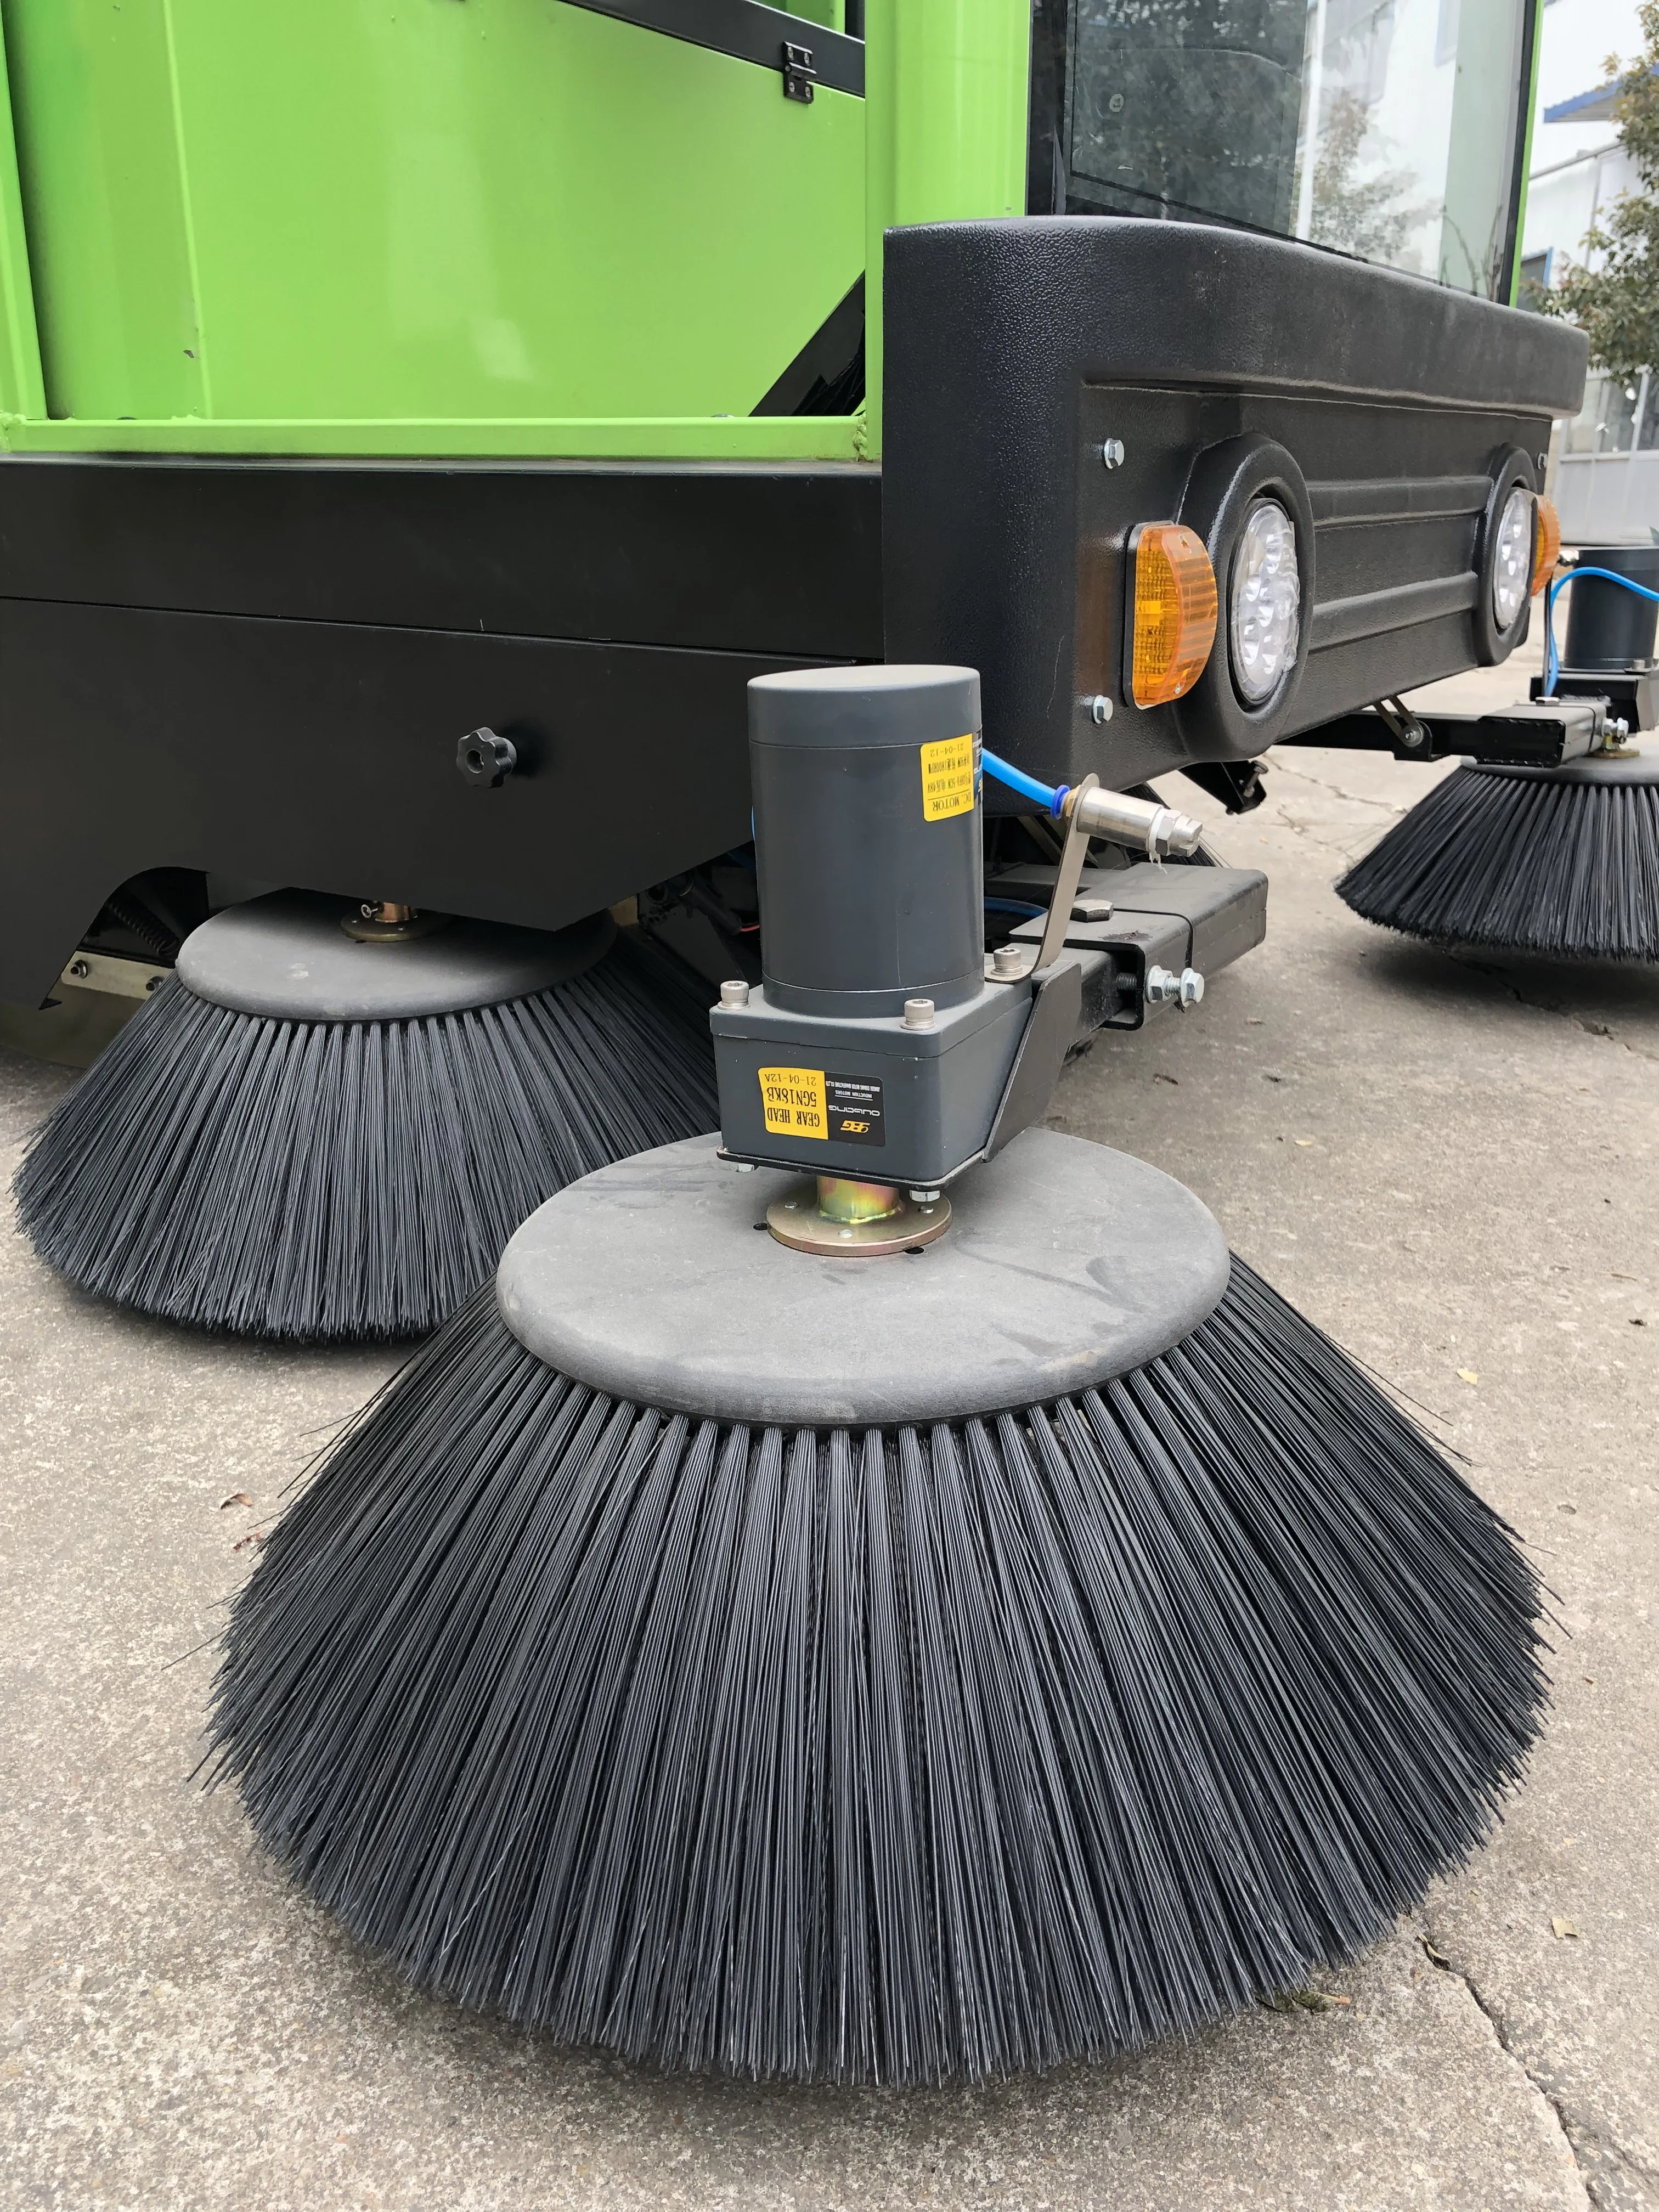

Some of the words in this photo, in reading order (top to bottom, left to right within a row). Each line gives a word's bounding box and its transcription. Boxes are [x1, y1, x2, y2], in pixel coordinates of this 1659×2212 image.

[930, 743, 964, 758] 21-04-12
[933, 797, 960, 812] MOTOR
[764, 1074, 816, 1086] 21-04-12A
[766, 1087, 816, 1107] 5GN18KB
[767, 1107, 791, 1124] HEAD
[796, 1110, 820, 1127] GEAR
